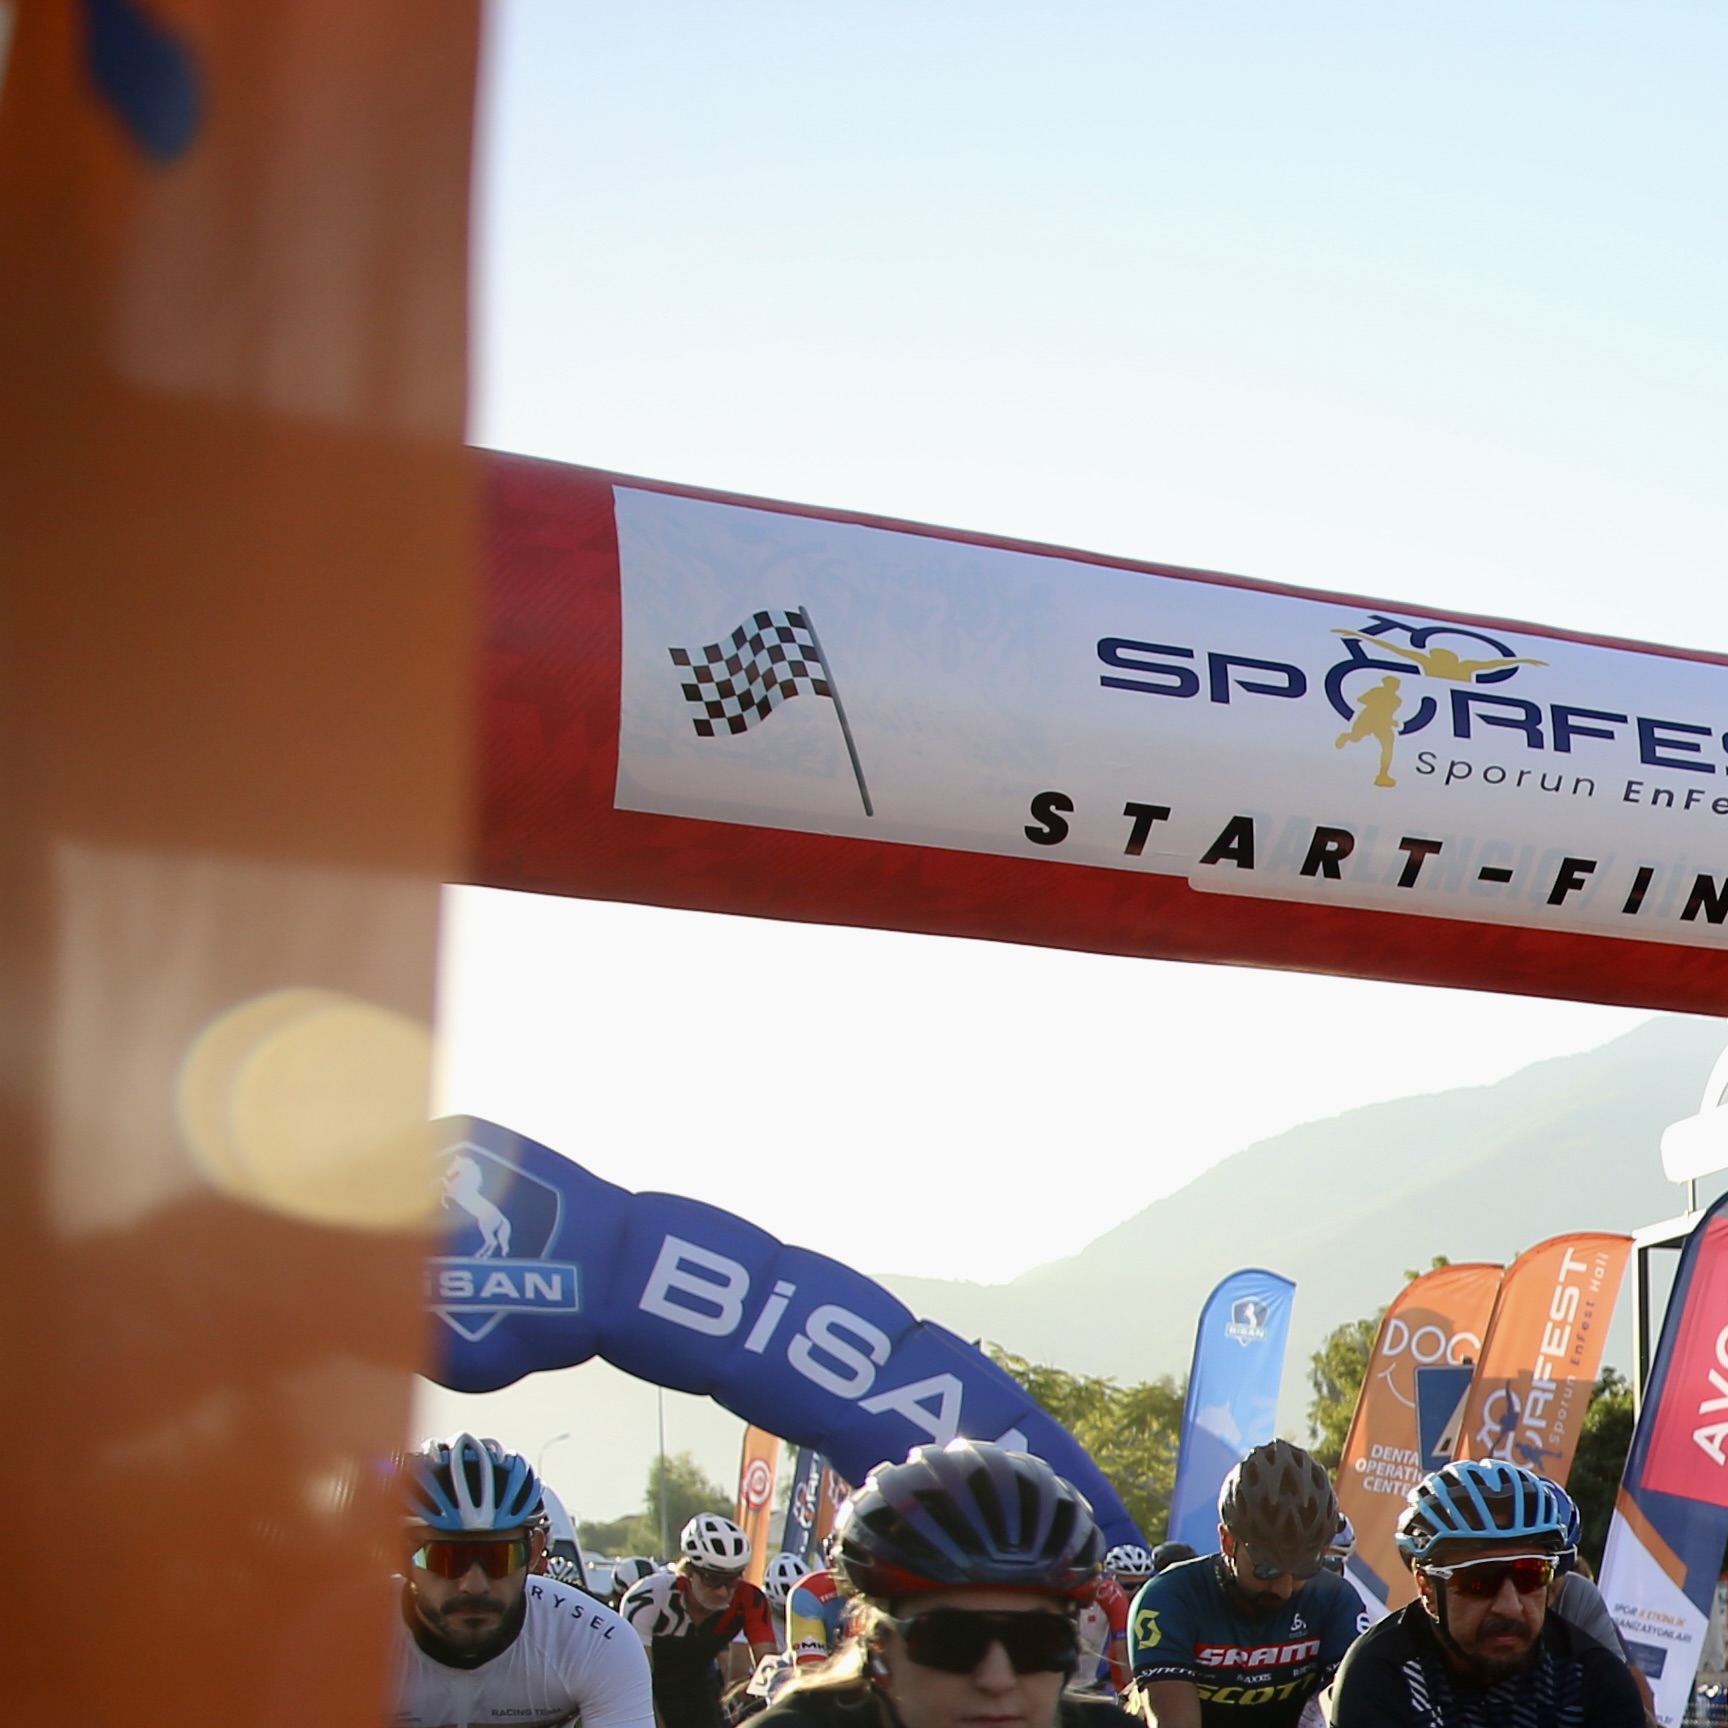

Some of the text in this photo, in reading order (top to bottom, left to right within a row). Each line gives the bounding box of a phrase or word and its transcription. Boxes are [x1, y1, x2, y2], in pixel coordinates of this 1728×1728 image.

[1416, 750, 1596, 798] Sporun
[638, 1234, 1030, 1455] BiSA
[1382, 1318, 1482, 1367] DOC
[1547, 1251, 1609, 1446] Sporun EnFest Hali
[1371, 1444, 1420, 1467] DENTA
[1363, 1475, 1414, 1497] CENTE
[1199, 1639, 1321, 1668] SRAM
